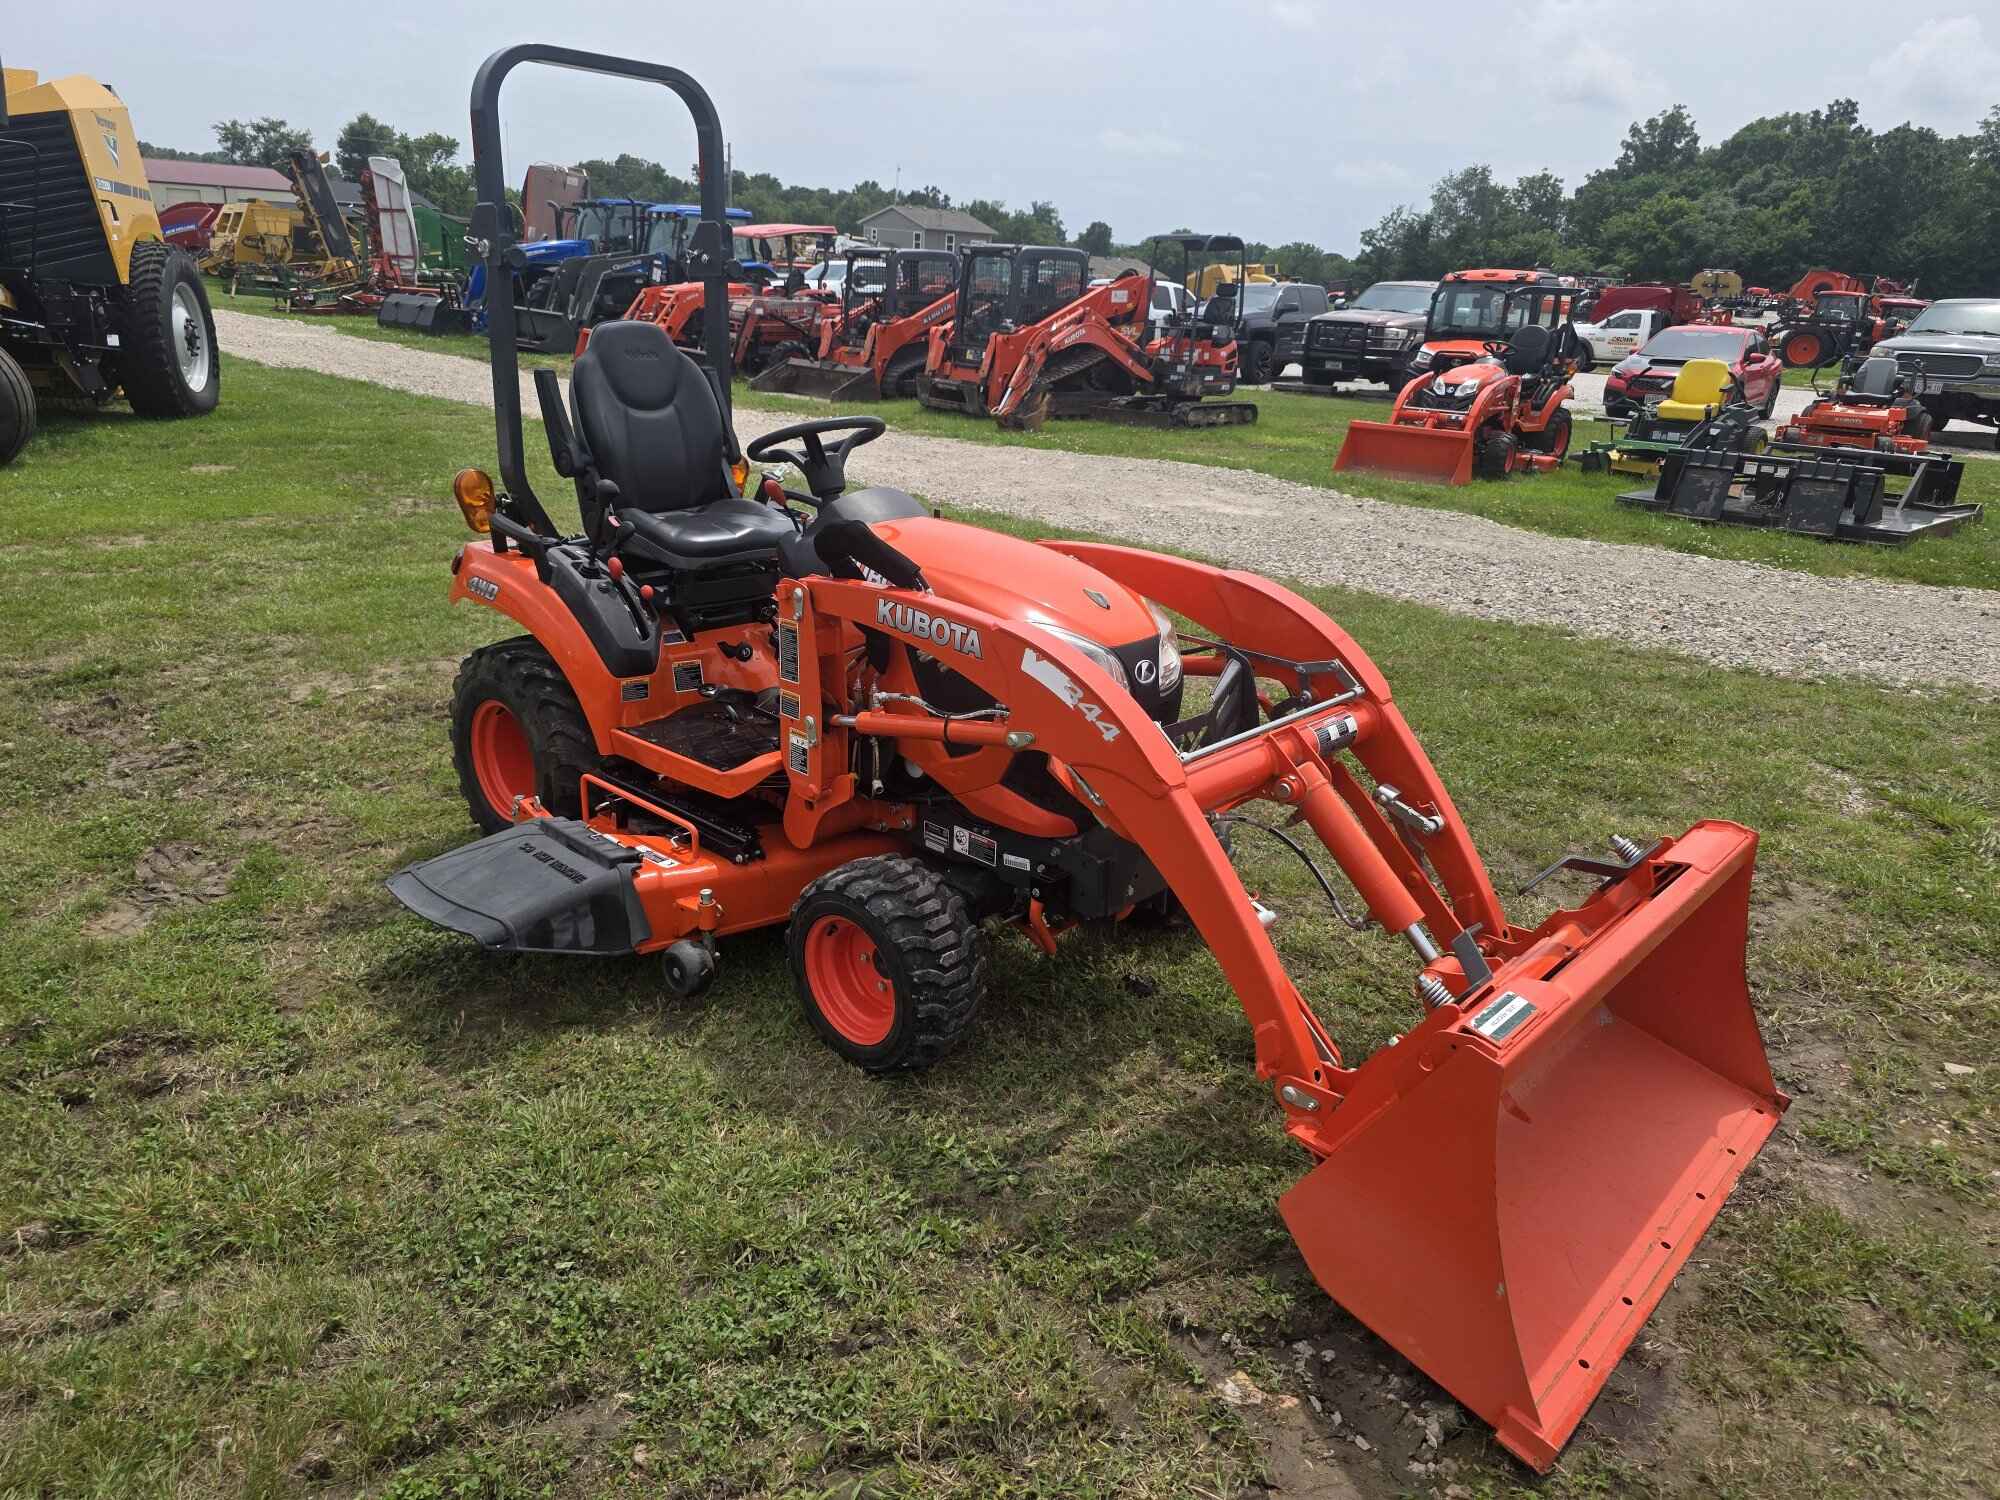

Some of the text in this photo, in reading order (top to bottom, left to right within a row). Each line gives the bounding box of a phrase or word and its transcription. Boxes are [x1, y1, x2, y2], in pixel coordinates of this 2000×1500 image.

[470, 576, 498, 600] 4WD
[877, 598, 983, 659] KUBOTA
[1063, 682, 1121, 742] 344
